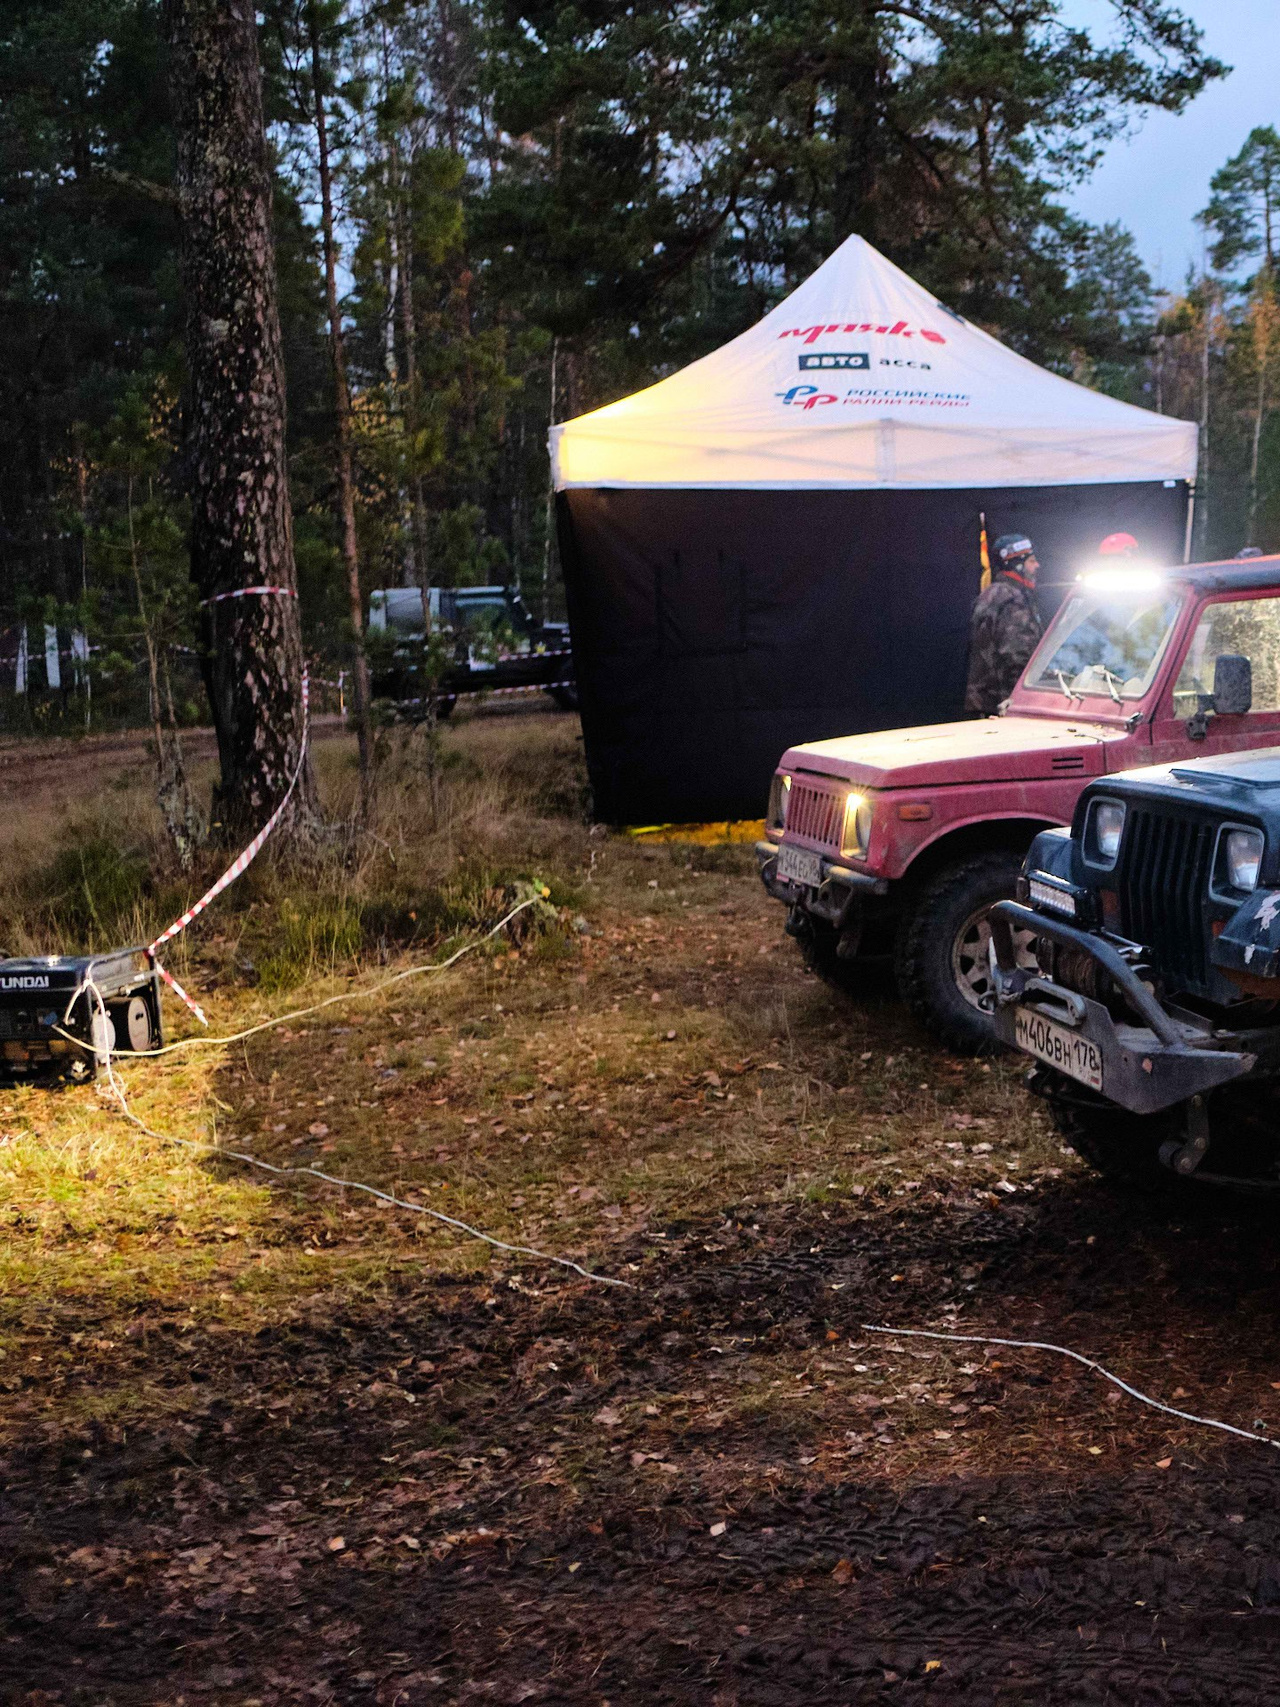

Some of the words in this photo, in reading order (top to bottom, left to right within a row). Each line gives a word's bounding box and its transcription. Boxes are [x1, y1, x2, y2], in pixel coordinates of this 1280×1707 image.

[847, 388, 972, 401] РОССИЙСКИЕ
[0, 975, 49, 989] UNDAI
[1019, 1016, 1072, 1069] М406ВН
[1074, 1039, 1098, 1071] 178
